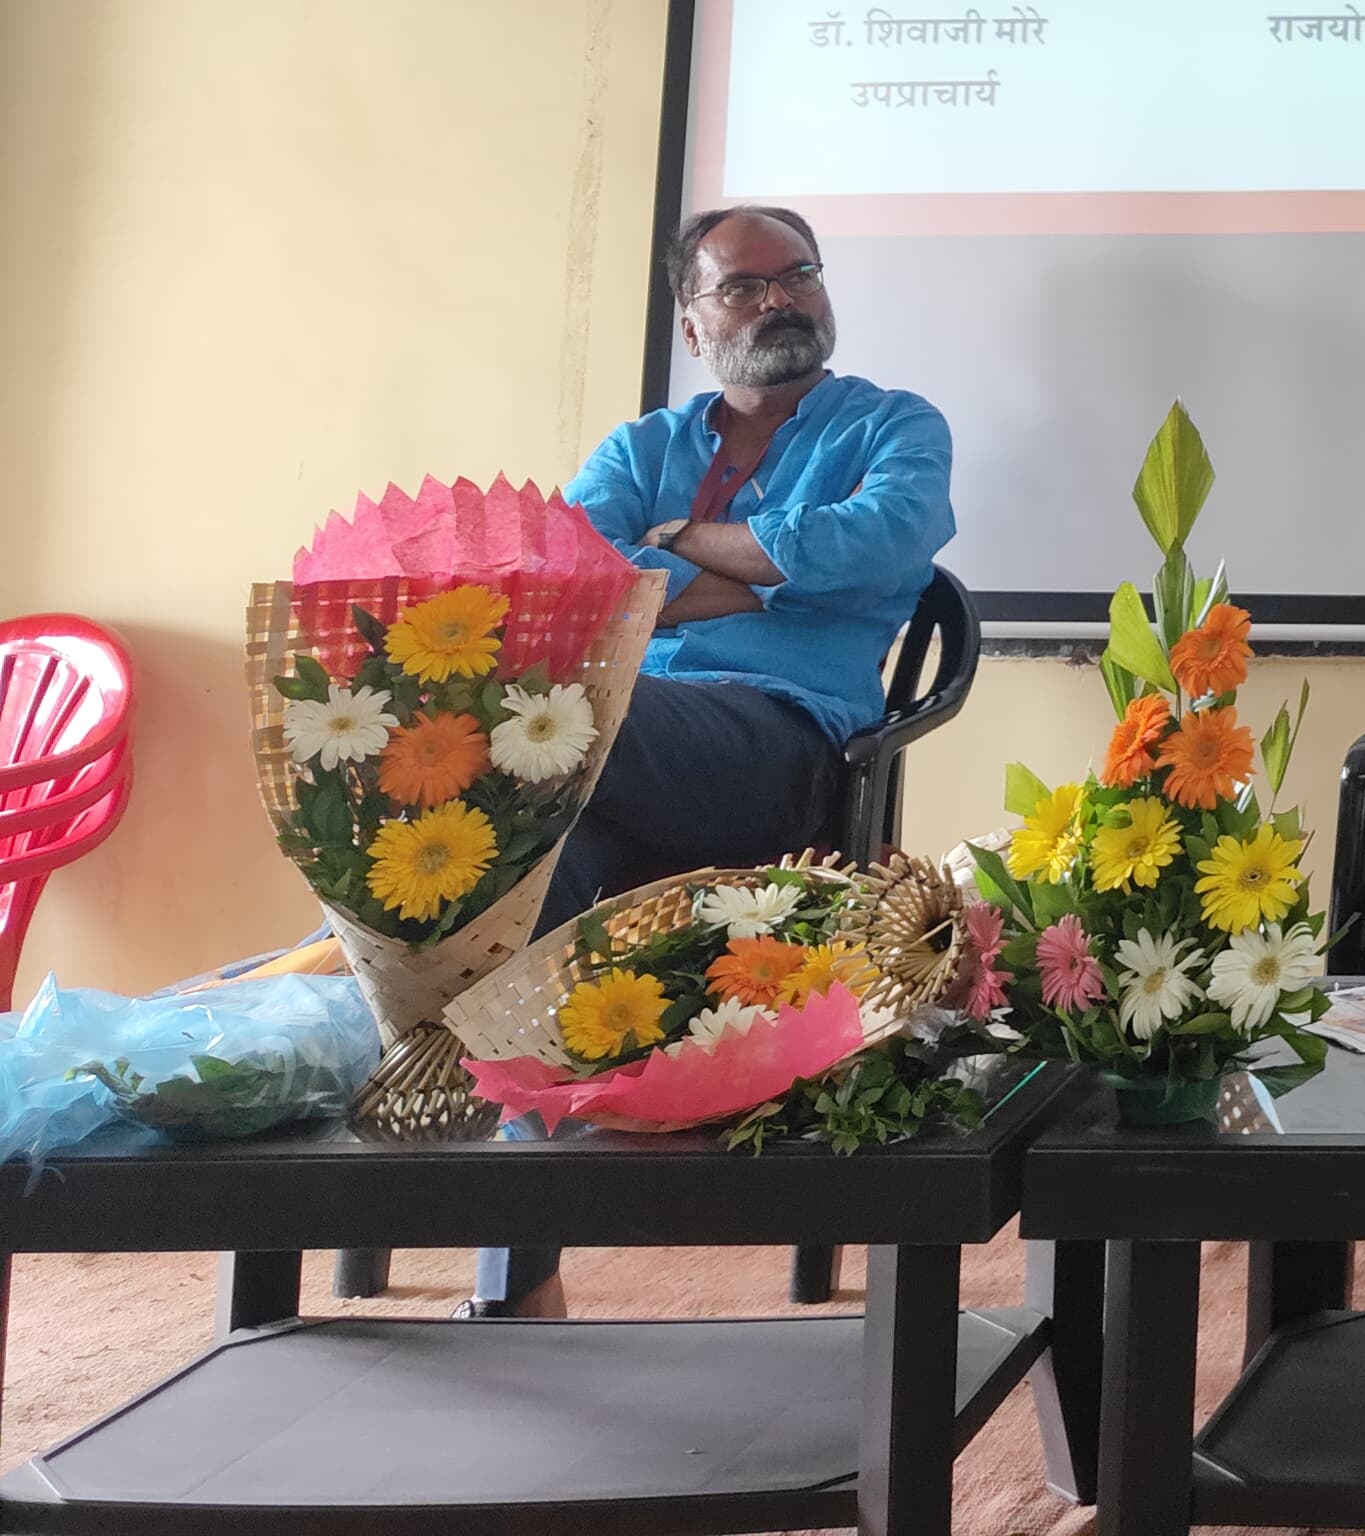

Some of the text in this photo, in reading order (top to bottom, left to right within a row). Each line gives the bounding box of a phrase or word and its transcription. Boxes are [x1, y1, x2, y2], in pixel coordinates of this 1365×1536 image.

[808, 6, 1048, 47] डॉ. शिवाजी मोरे
[851, 69, 1001, 107] उपप्राचार्य
